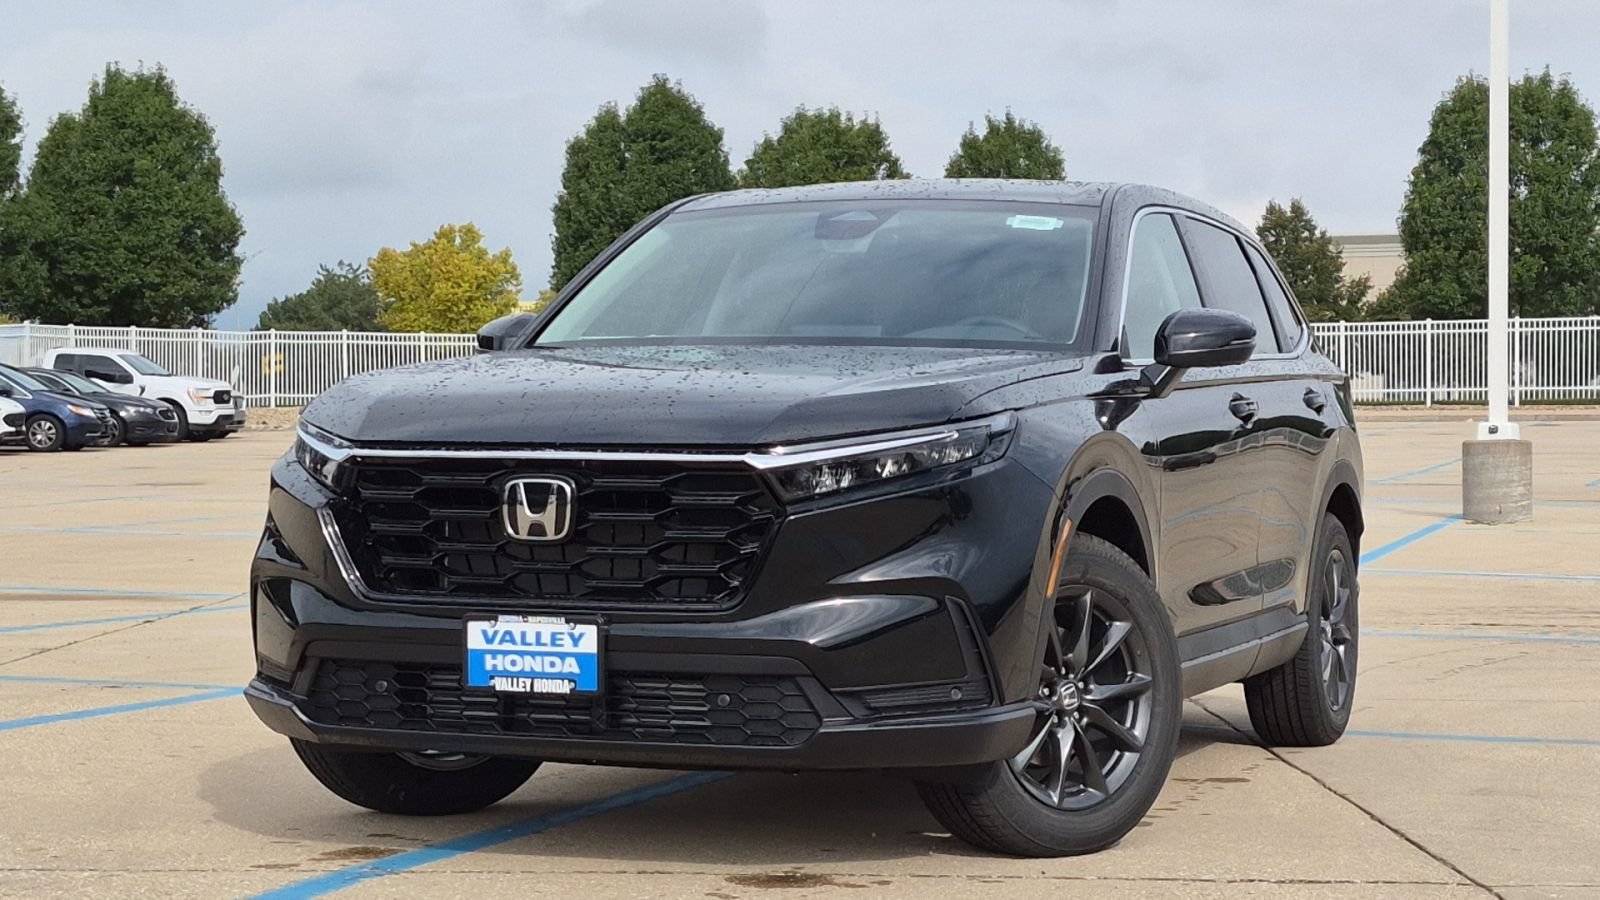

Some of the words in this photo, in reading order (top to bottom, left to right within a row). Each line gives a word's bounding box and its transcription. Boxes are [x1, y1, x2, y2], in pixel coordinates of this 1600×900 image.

[481, 629, 586, 648] VALLEY
[484, 654, 580, 674] HONDA
[494, 676, 532, 692] VALLEY
[533, 678, 571, 694] HONDA
